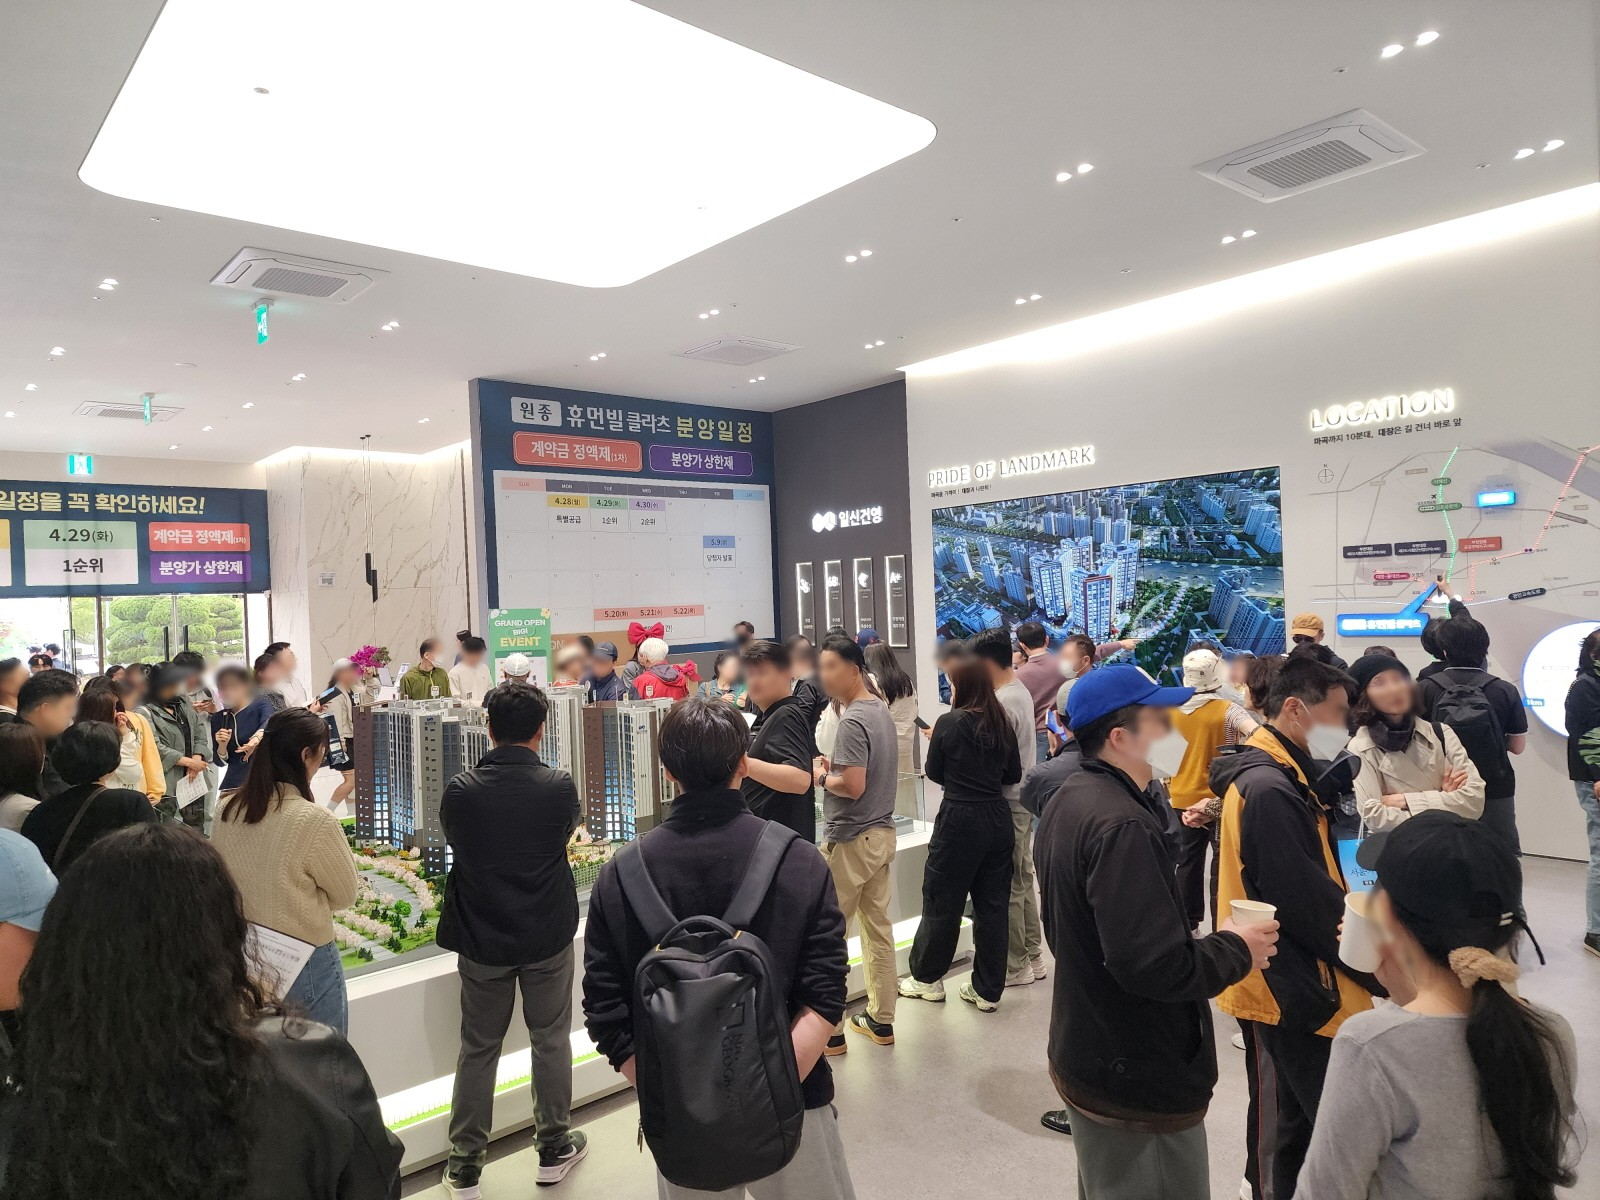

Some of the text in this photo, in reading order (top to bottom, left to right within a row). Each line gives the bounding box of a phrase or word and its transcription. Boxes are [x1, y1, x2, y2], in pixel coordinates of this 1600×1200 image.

[519, 401, 553, 422] 원종
[566, 404, 624, 432] 휴먼빌
[626, 410, 671, 434] 클라츠
[1310, 389, 1452, 430] LOCATION
[1313, 418, 1463, 445] 마곡까지 10분대, 대장은 길 건너 바로 앞
[531, 440, 628, 463] 계약금 정액제(1차)
[671, 452, 734, 470] 분양가 상한제
[928, 447, 1092, 486] PRIDE OF LANDMARK
[0, 490, 205, 515] 일정을 꼭 확인하세요!
[555, 514, 656, 526] 특별공급 1순위 2순위
[838, 505, 884, 528] 일신건영
[49, 528, 114, 543] 4.29(화)
[153, 528, 247, 545] 계약금 정액제(1차)
[62, 558, 104, 574] 1순위
[706, 554, 733, 563] 당첨자 발표
[159, 560, 244, 576] 분양가 상한제
[494, 619, 522, 627] GRAND
[500, 636, 541, 647] EVENT
